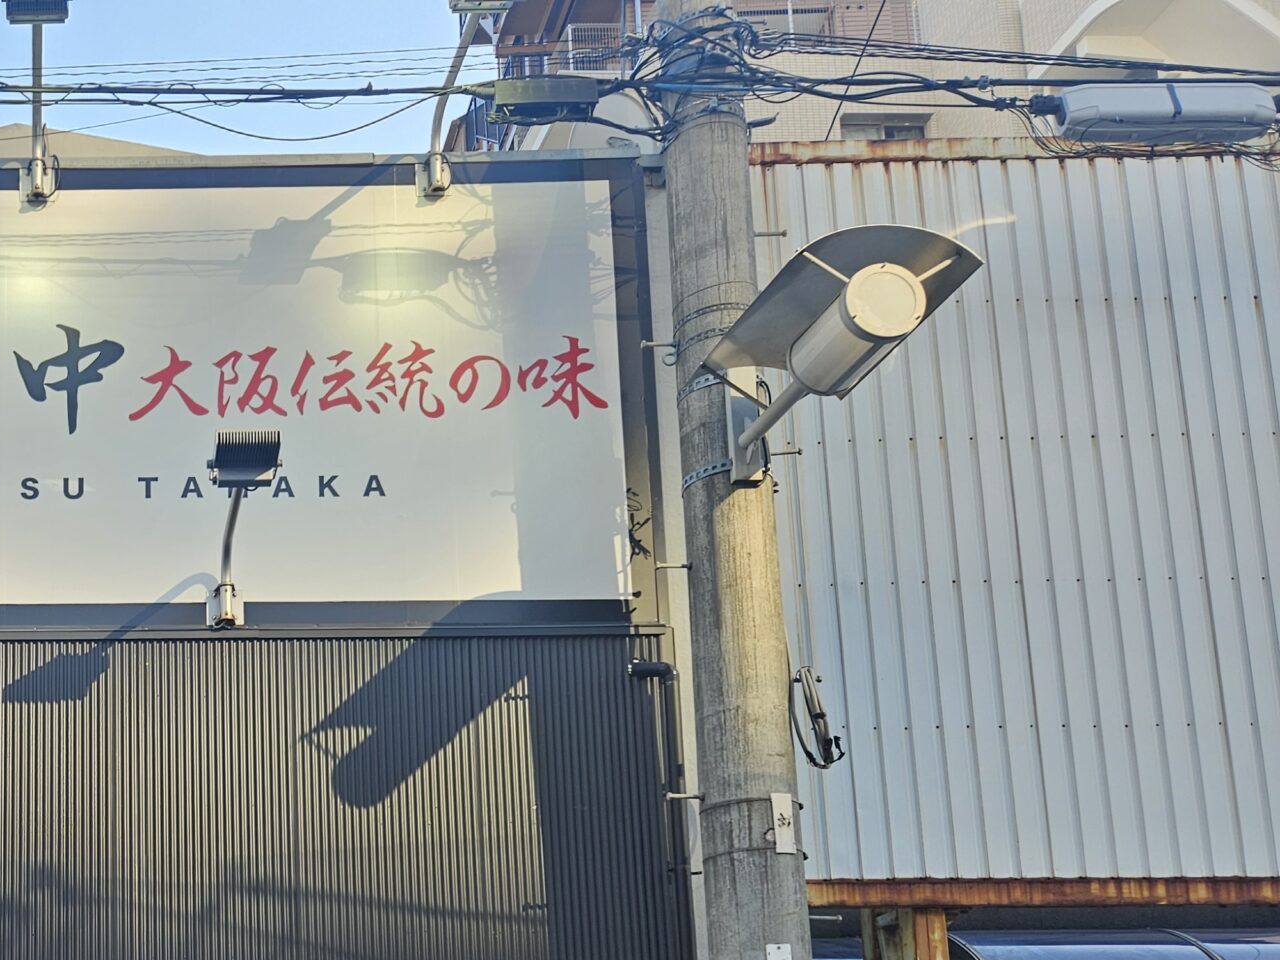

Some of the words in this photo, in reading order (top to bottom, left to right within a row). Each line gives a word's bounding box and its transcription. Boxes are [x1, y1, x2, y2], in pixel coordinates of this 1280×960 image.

[128, 335, 609, 420] 大阪伝統の味
[138, 474, 386, 499] TAAKA
